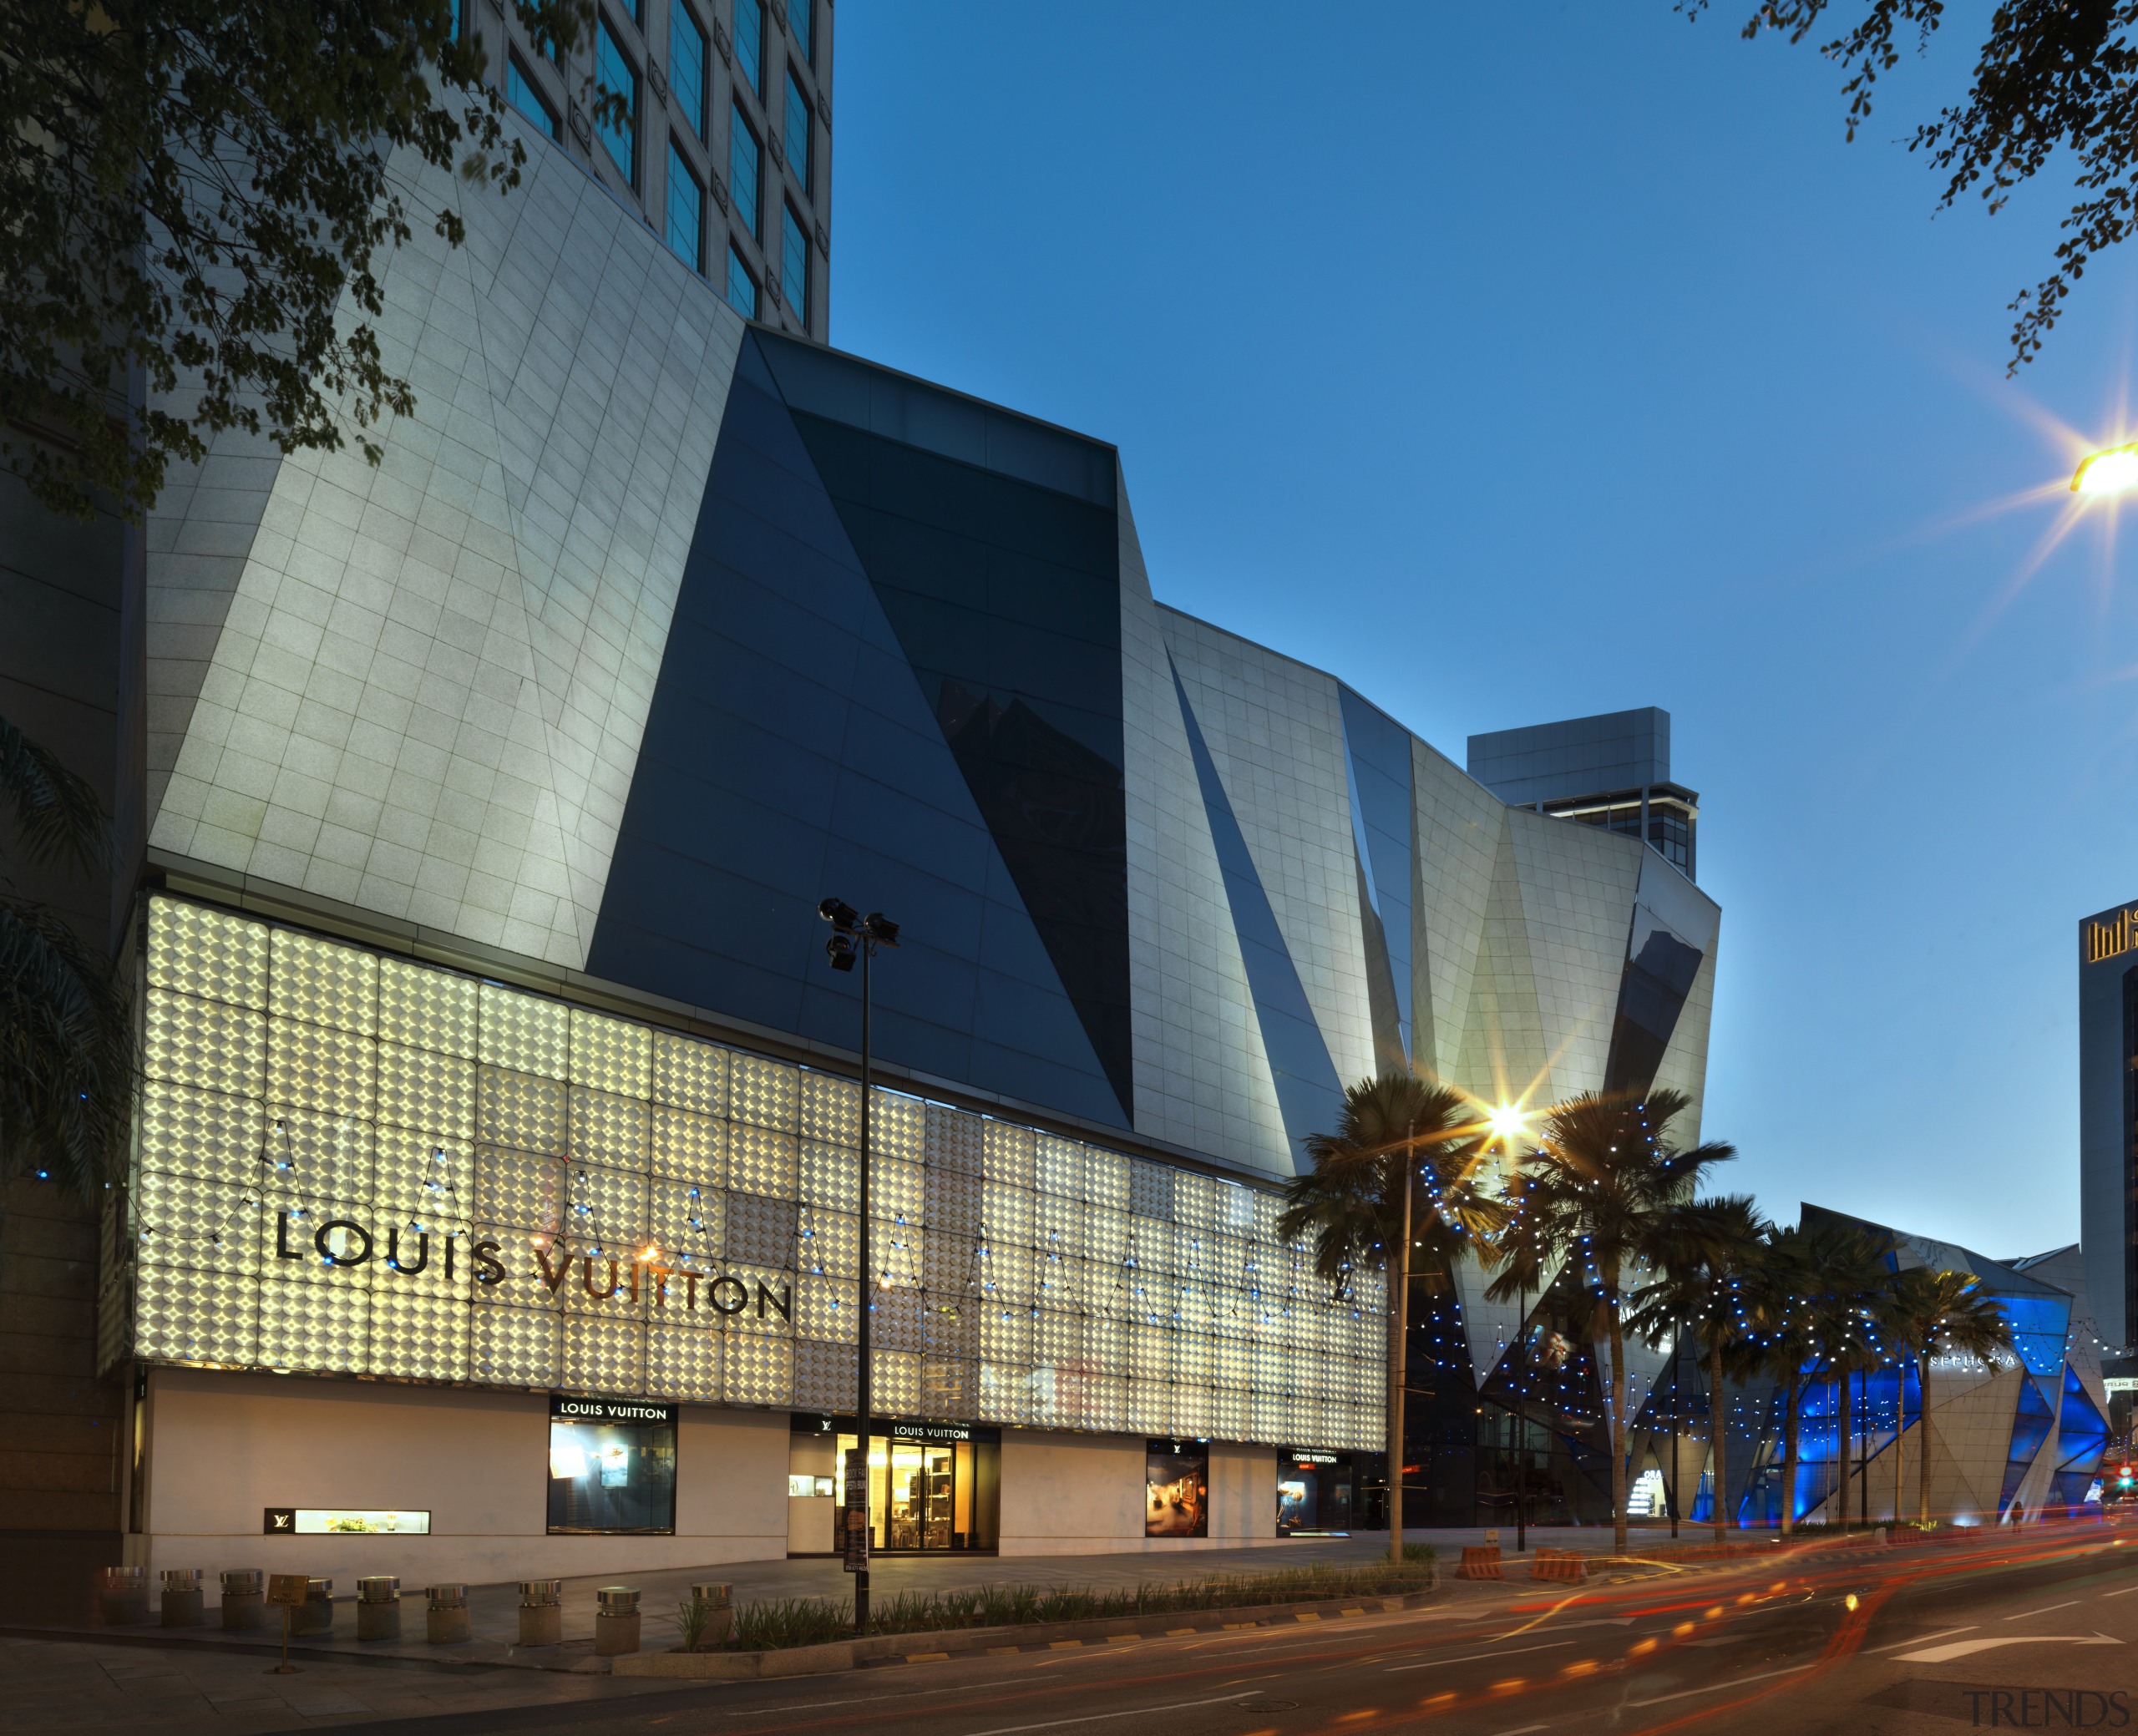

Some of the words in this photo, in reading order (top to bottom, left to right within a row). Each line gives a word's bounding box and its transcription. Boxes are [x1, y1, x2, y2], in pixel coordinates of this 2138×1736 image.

[276, 1211, 506, 1286] LOUIS
[534, 1248, 792, 1324] VUITTON
[560, 1402, 603, 1415] LOUIS
[607, 1405, 666, 1420] VUITTON
[894, 1425, 924, 1436] LOUIS
[927, 1428, 969, 1440] VUITTON
[1292, 1453, 1310, 1462] LOUIS
[1311, 1455, 1337, 1464] VUITTON
